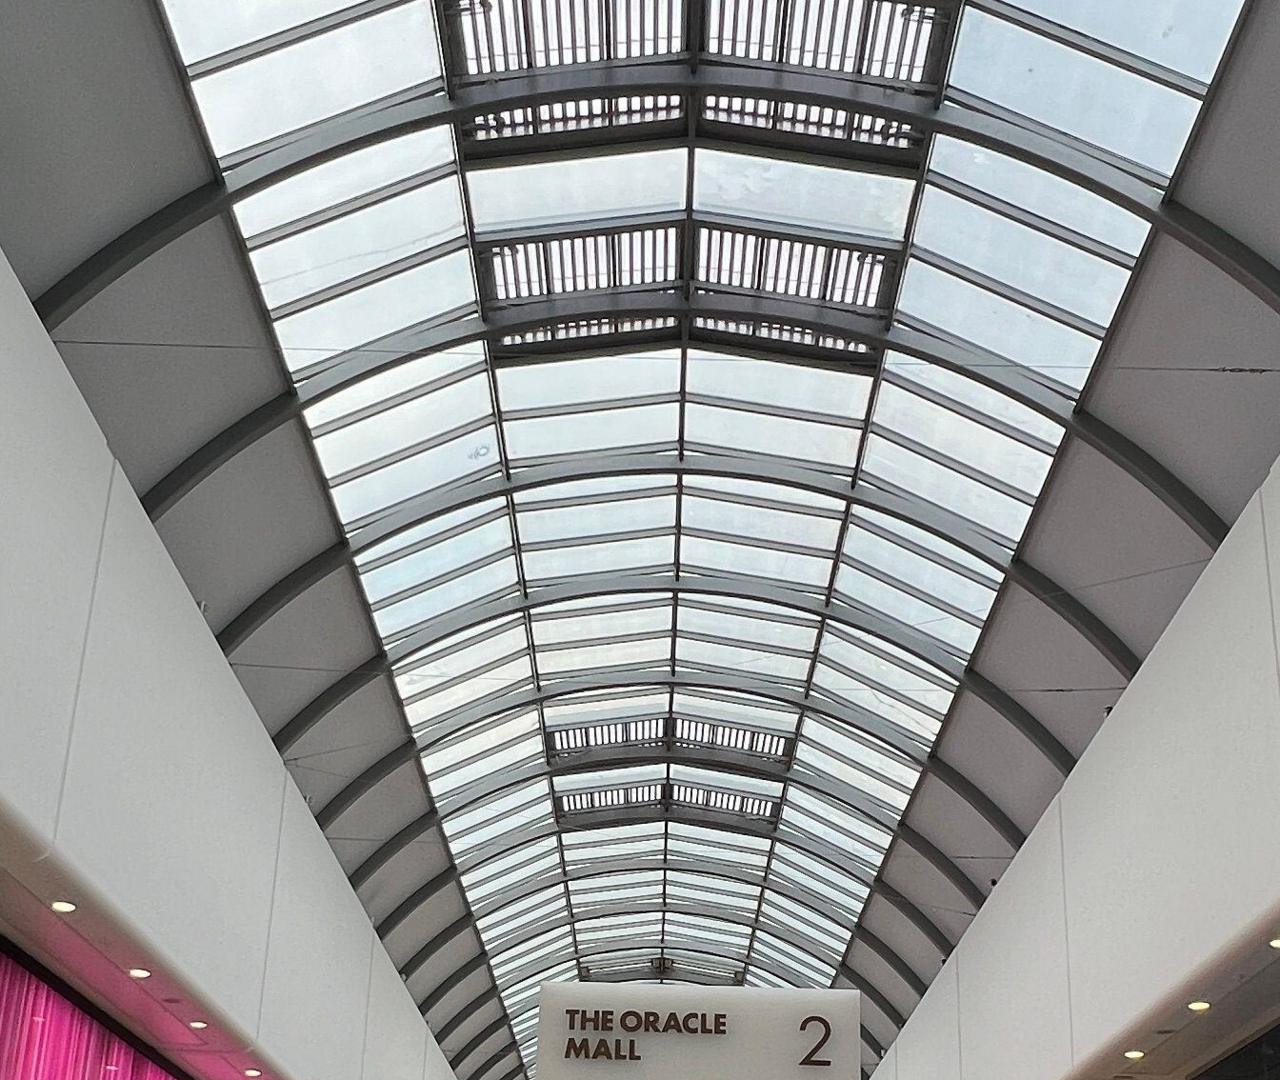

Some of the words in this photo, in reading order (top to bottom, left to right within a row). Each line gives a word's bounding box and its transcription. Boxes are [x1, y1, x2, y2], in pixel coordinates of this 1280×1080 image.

[565, 1009, 614, 1031] THE
[620, 1010, 726, 1034] ORACLE
[564, 1038, 641, 1060] MALL
[798, 1015, 831, 1066] 2
